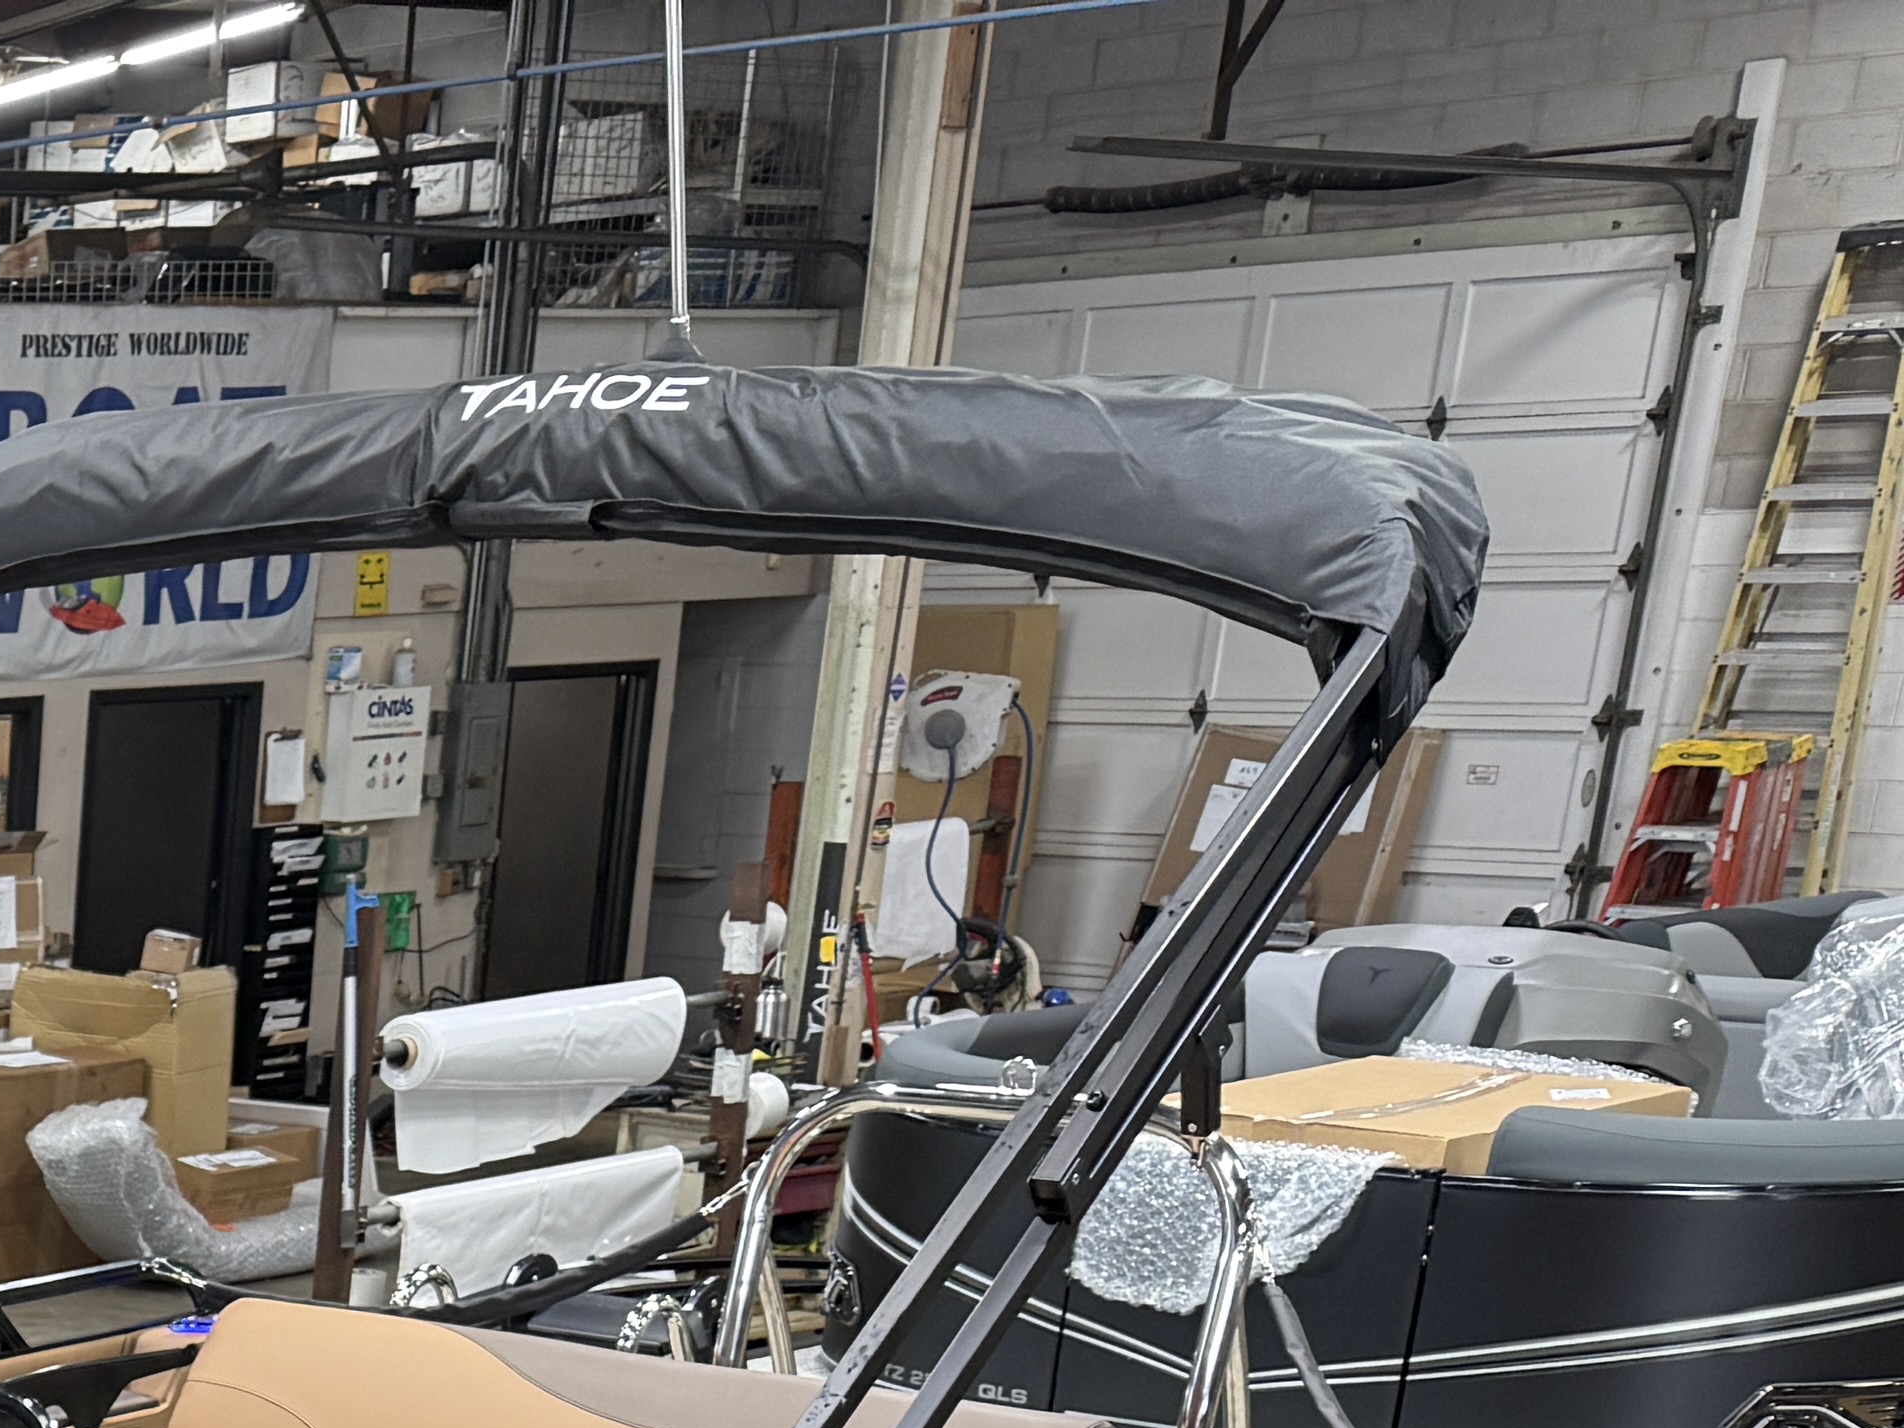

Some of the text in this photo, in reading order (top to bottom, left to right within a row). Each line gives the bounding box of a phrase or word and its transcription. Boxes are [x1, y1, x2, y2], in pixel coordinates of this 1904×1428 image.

[20, 332, 250, 358] PRESTIGE WORLDWIDE
[461, 372, 710, 421] TAHOE
[803, 908, 840, 1043] TAHE
[978, 1384, 1028, 1404] QLS
